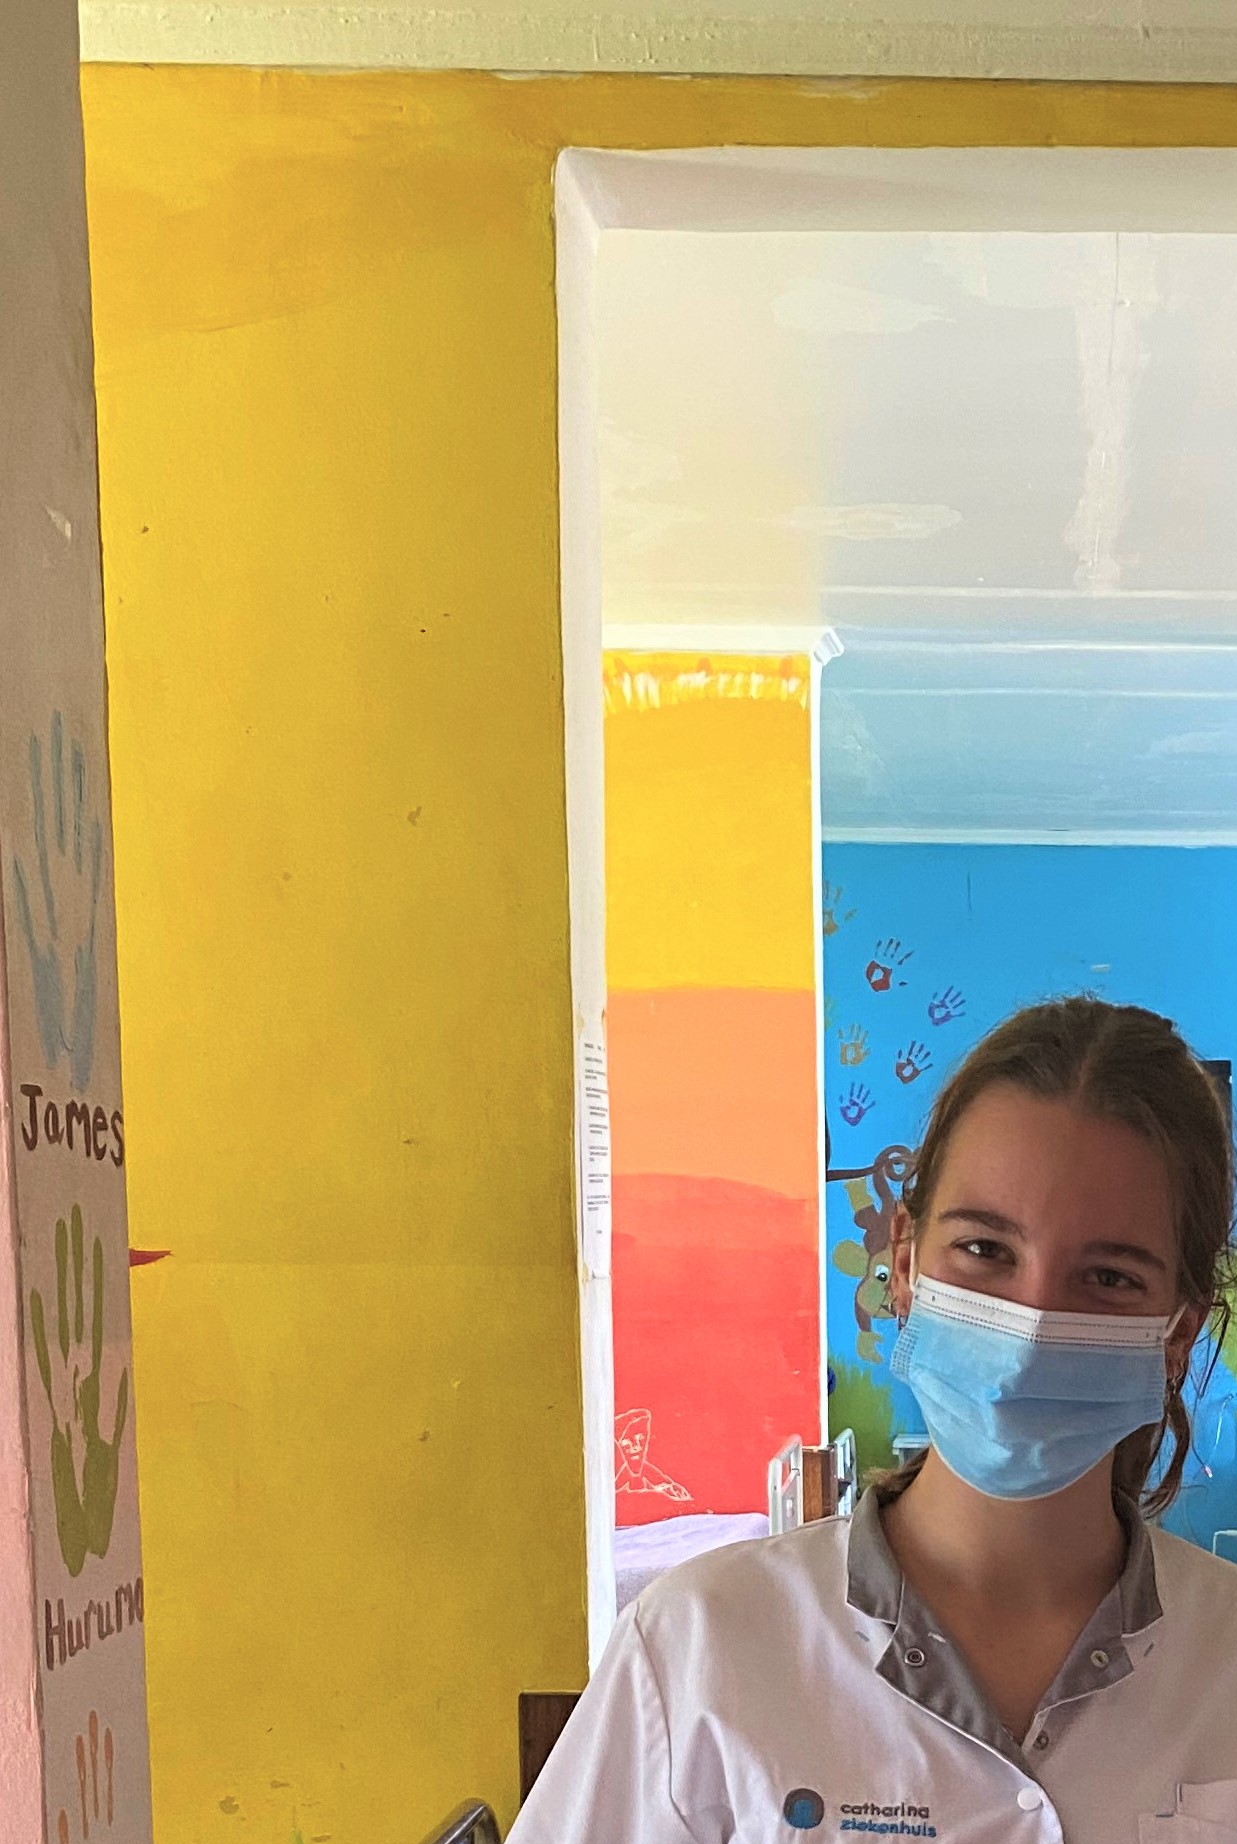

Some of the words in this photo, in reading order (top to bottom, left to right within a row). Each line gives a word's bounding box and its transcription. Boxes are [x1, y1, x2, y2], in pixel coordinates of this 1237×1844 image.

[20, 1085, 124, 1168] James
[840, 1802, 930, 1819] catharina
[840, 1818, 937, 1838] ziekenhuis
